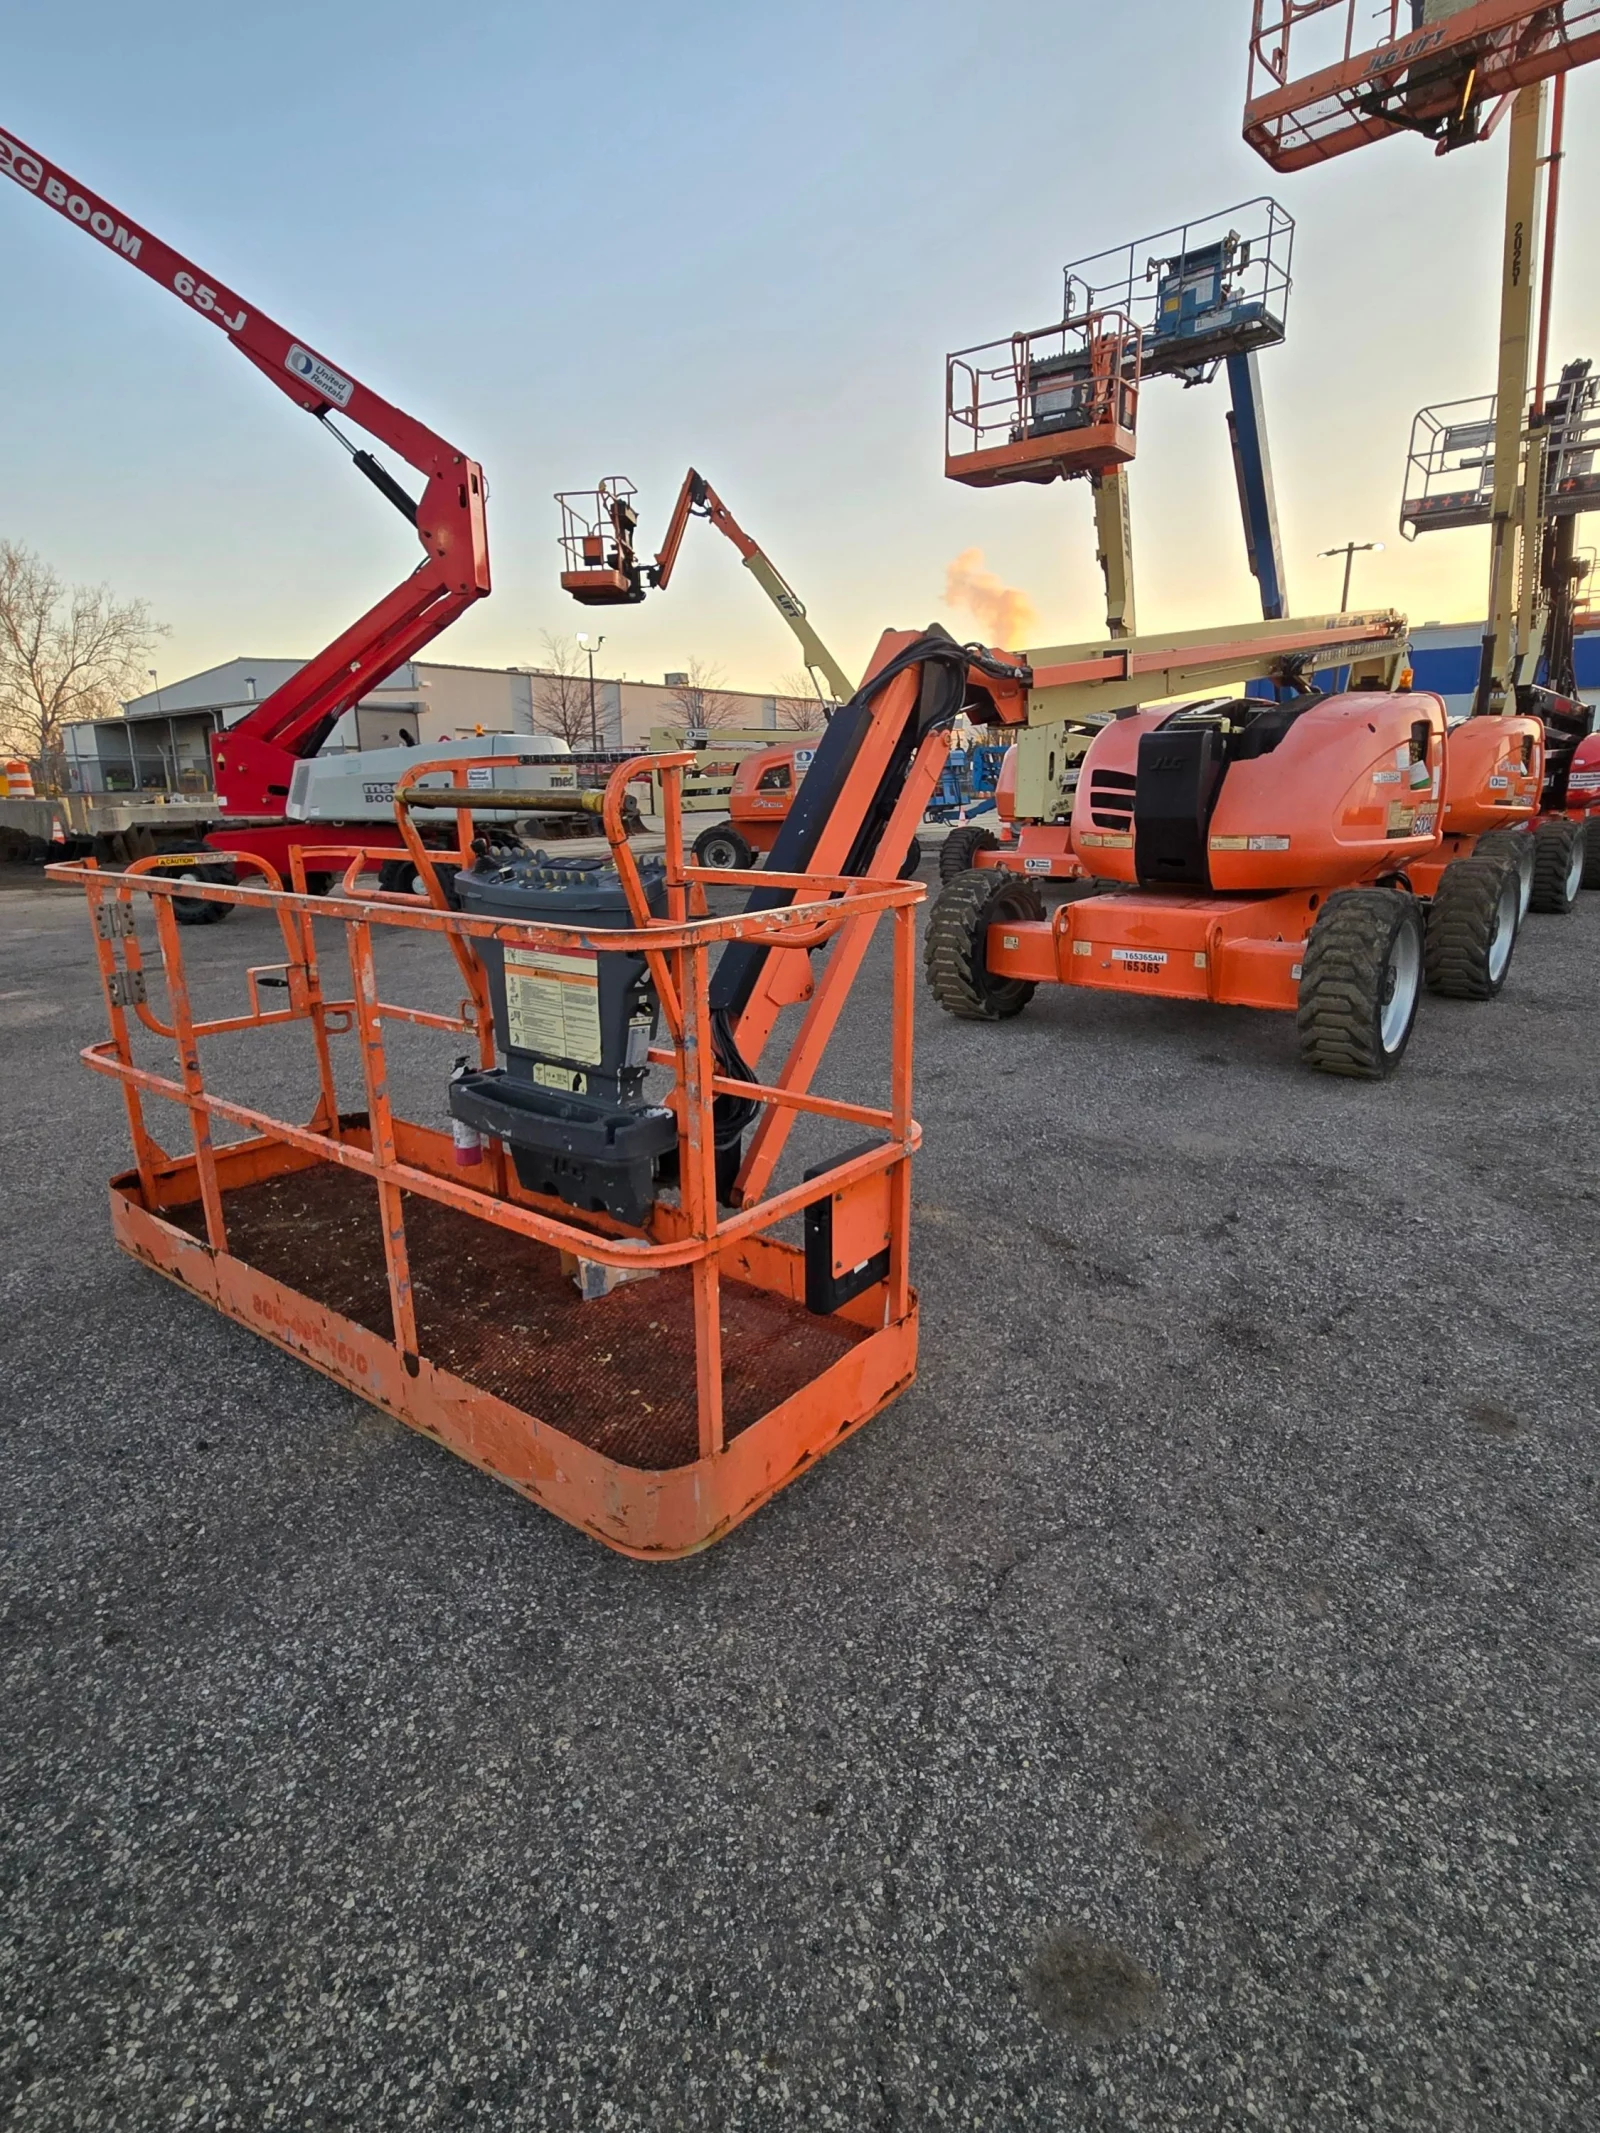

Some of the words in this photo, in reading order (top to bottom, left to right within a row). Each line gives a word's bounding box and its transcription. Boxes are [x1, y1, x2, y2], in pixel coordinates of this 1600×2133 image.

[43, 176, 143, 260] BOOM
[173, 271, 248, 331] 65-J
[315, 365, 347, 390] United
[310, 373, 345, 401] Rentals
[776, 594, 800, 617] LIFT
[550, 775, 574, 788] mec
[365, 794, 394, 803] BOO
[166, 857, 194, 865] CAUTION
[1125, 952, 1164, 962] 165365AH
[1123, 960, 1160, 974] 165365
